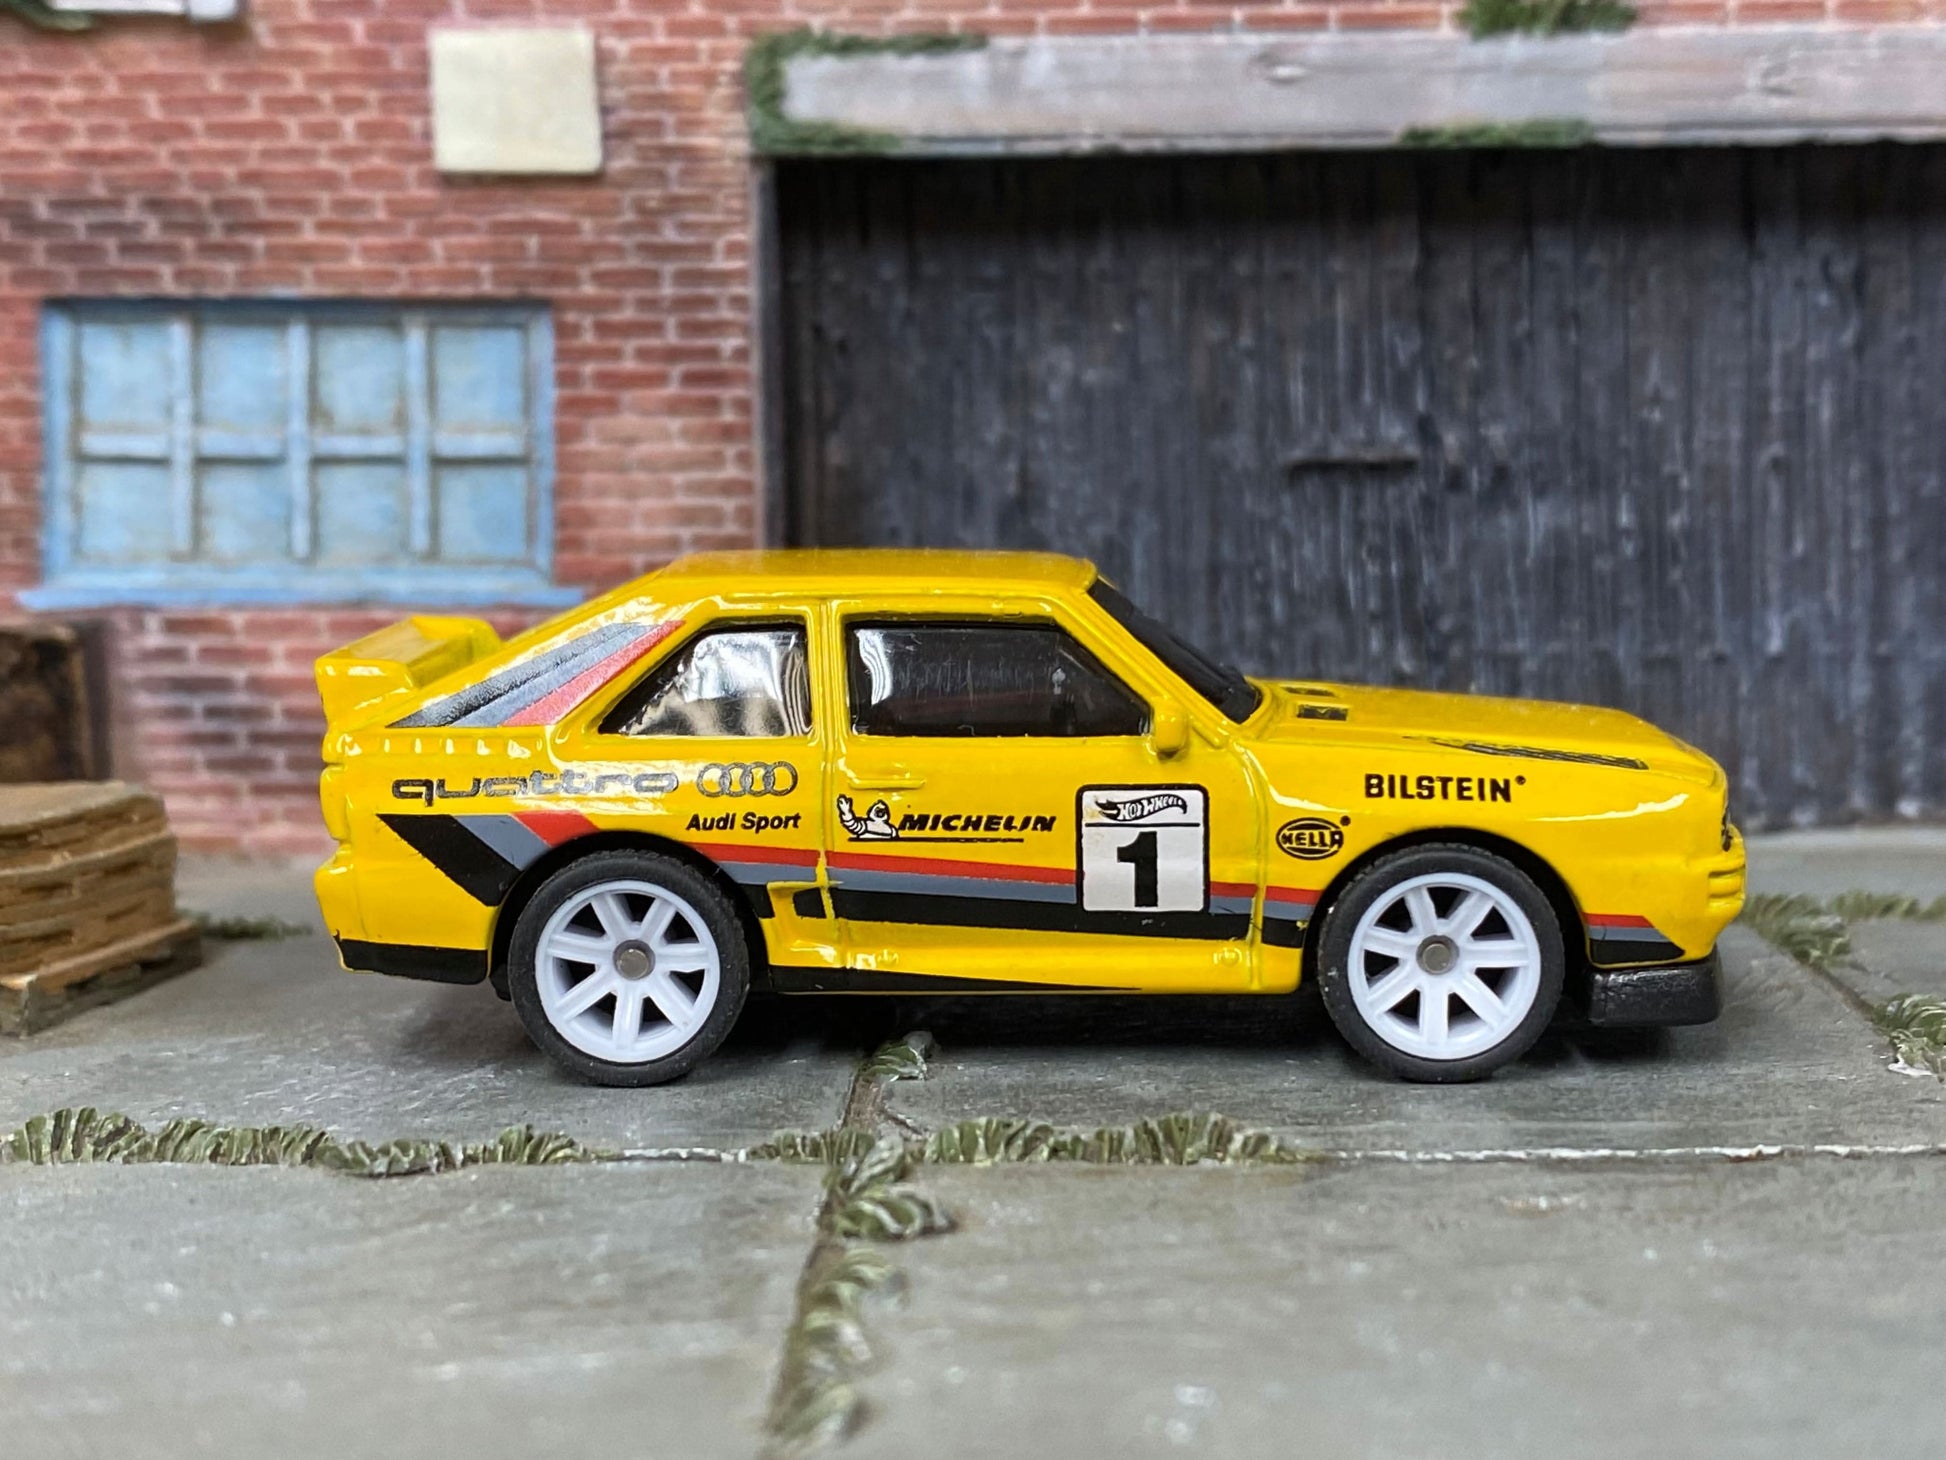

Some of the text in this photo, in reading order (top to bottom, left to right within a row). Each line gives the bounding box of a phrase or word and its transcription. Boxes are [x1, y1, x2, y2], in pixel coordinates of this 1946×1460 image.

[392, 769, 679, 807] quattro
[1364, 774, 1512, 802] BILSTEIN
[687, 812, 801, 832] Audi Sport
[897, 814, 1057, 832] MICHELIN
[1281, 830, 1344, 849] HELLA
[1117, 831, 1158, 907] 1
